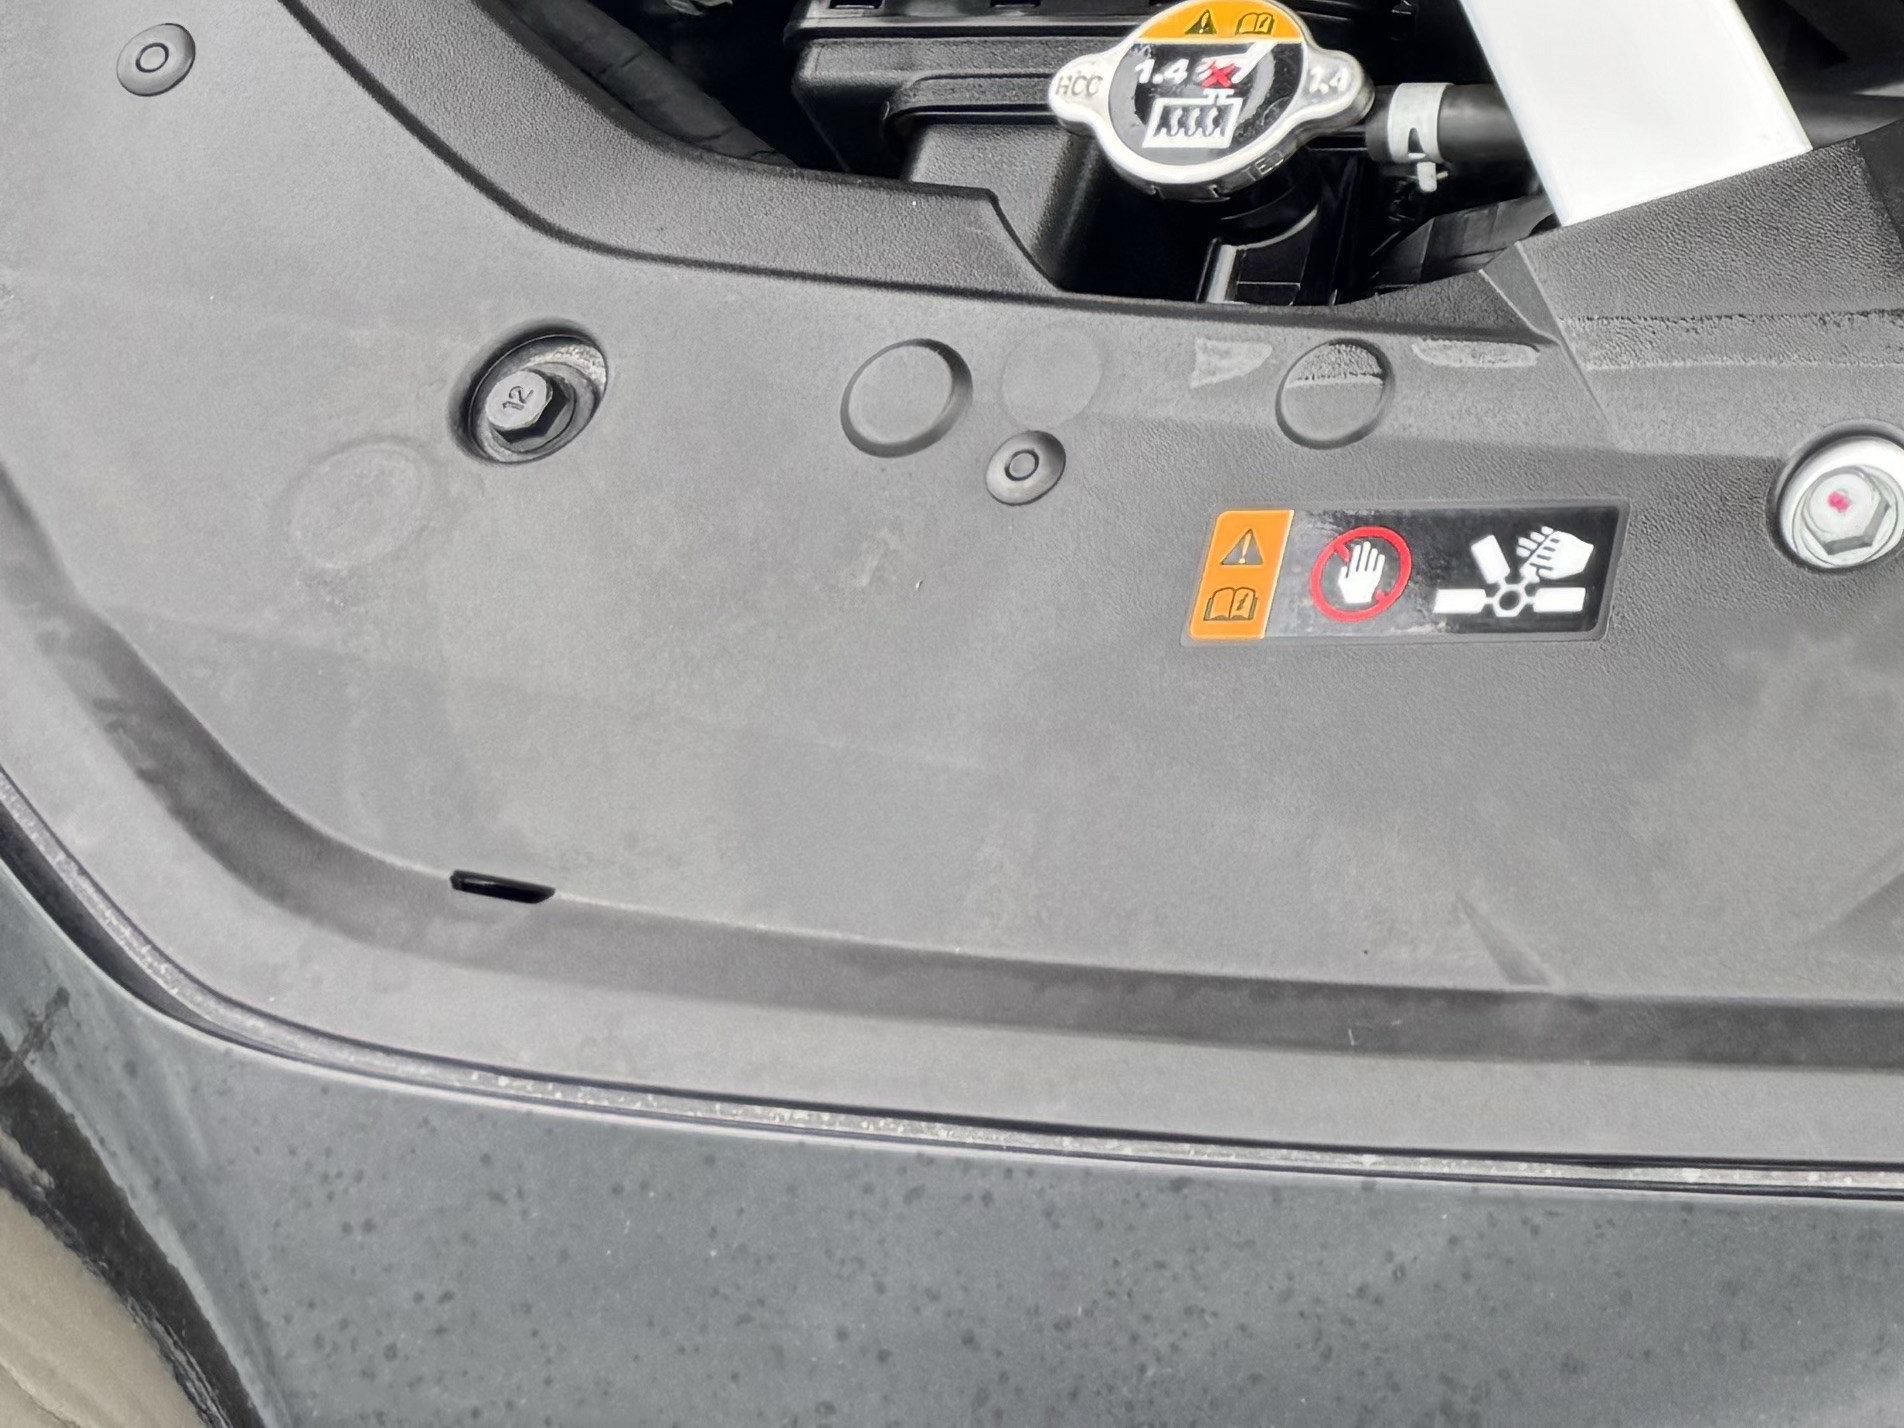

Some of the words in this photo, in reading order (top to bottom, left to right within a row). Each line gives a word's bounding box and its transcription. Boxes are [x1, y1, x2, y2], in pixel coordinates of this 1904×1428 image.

[1134, 58, 1190, 85] 1.4
[1309, 66, 1350, 95] 1.4
[1054, 73, 1104, 98] HCC
